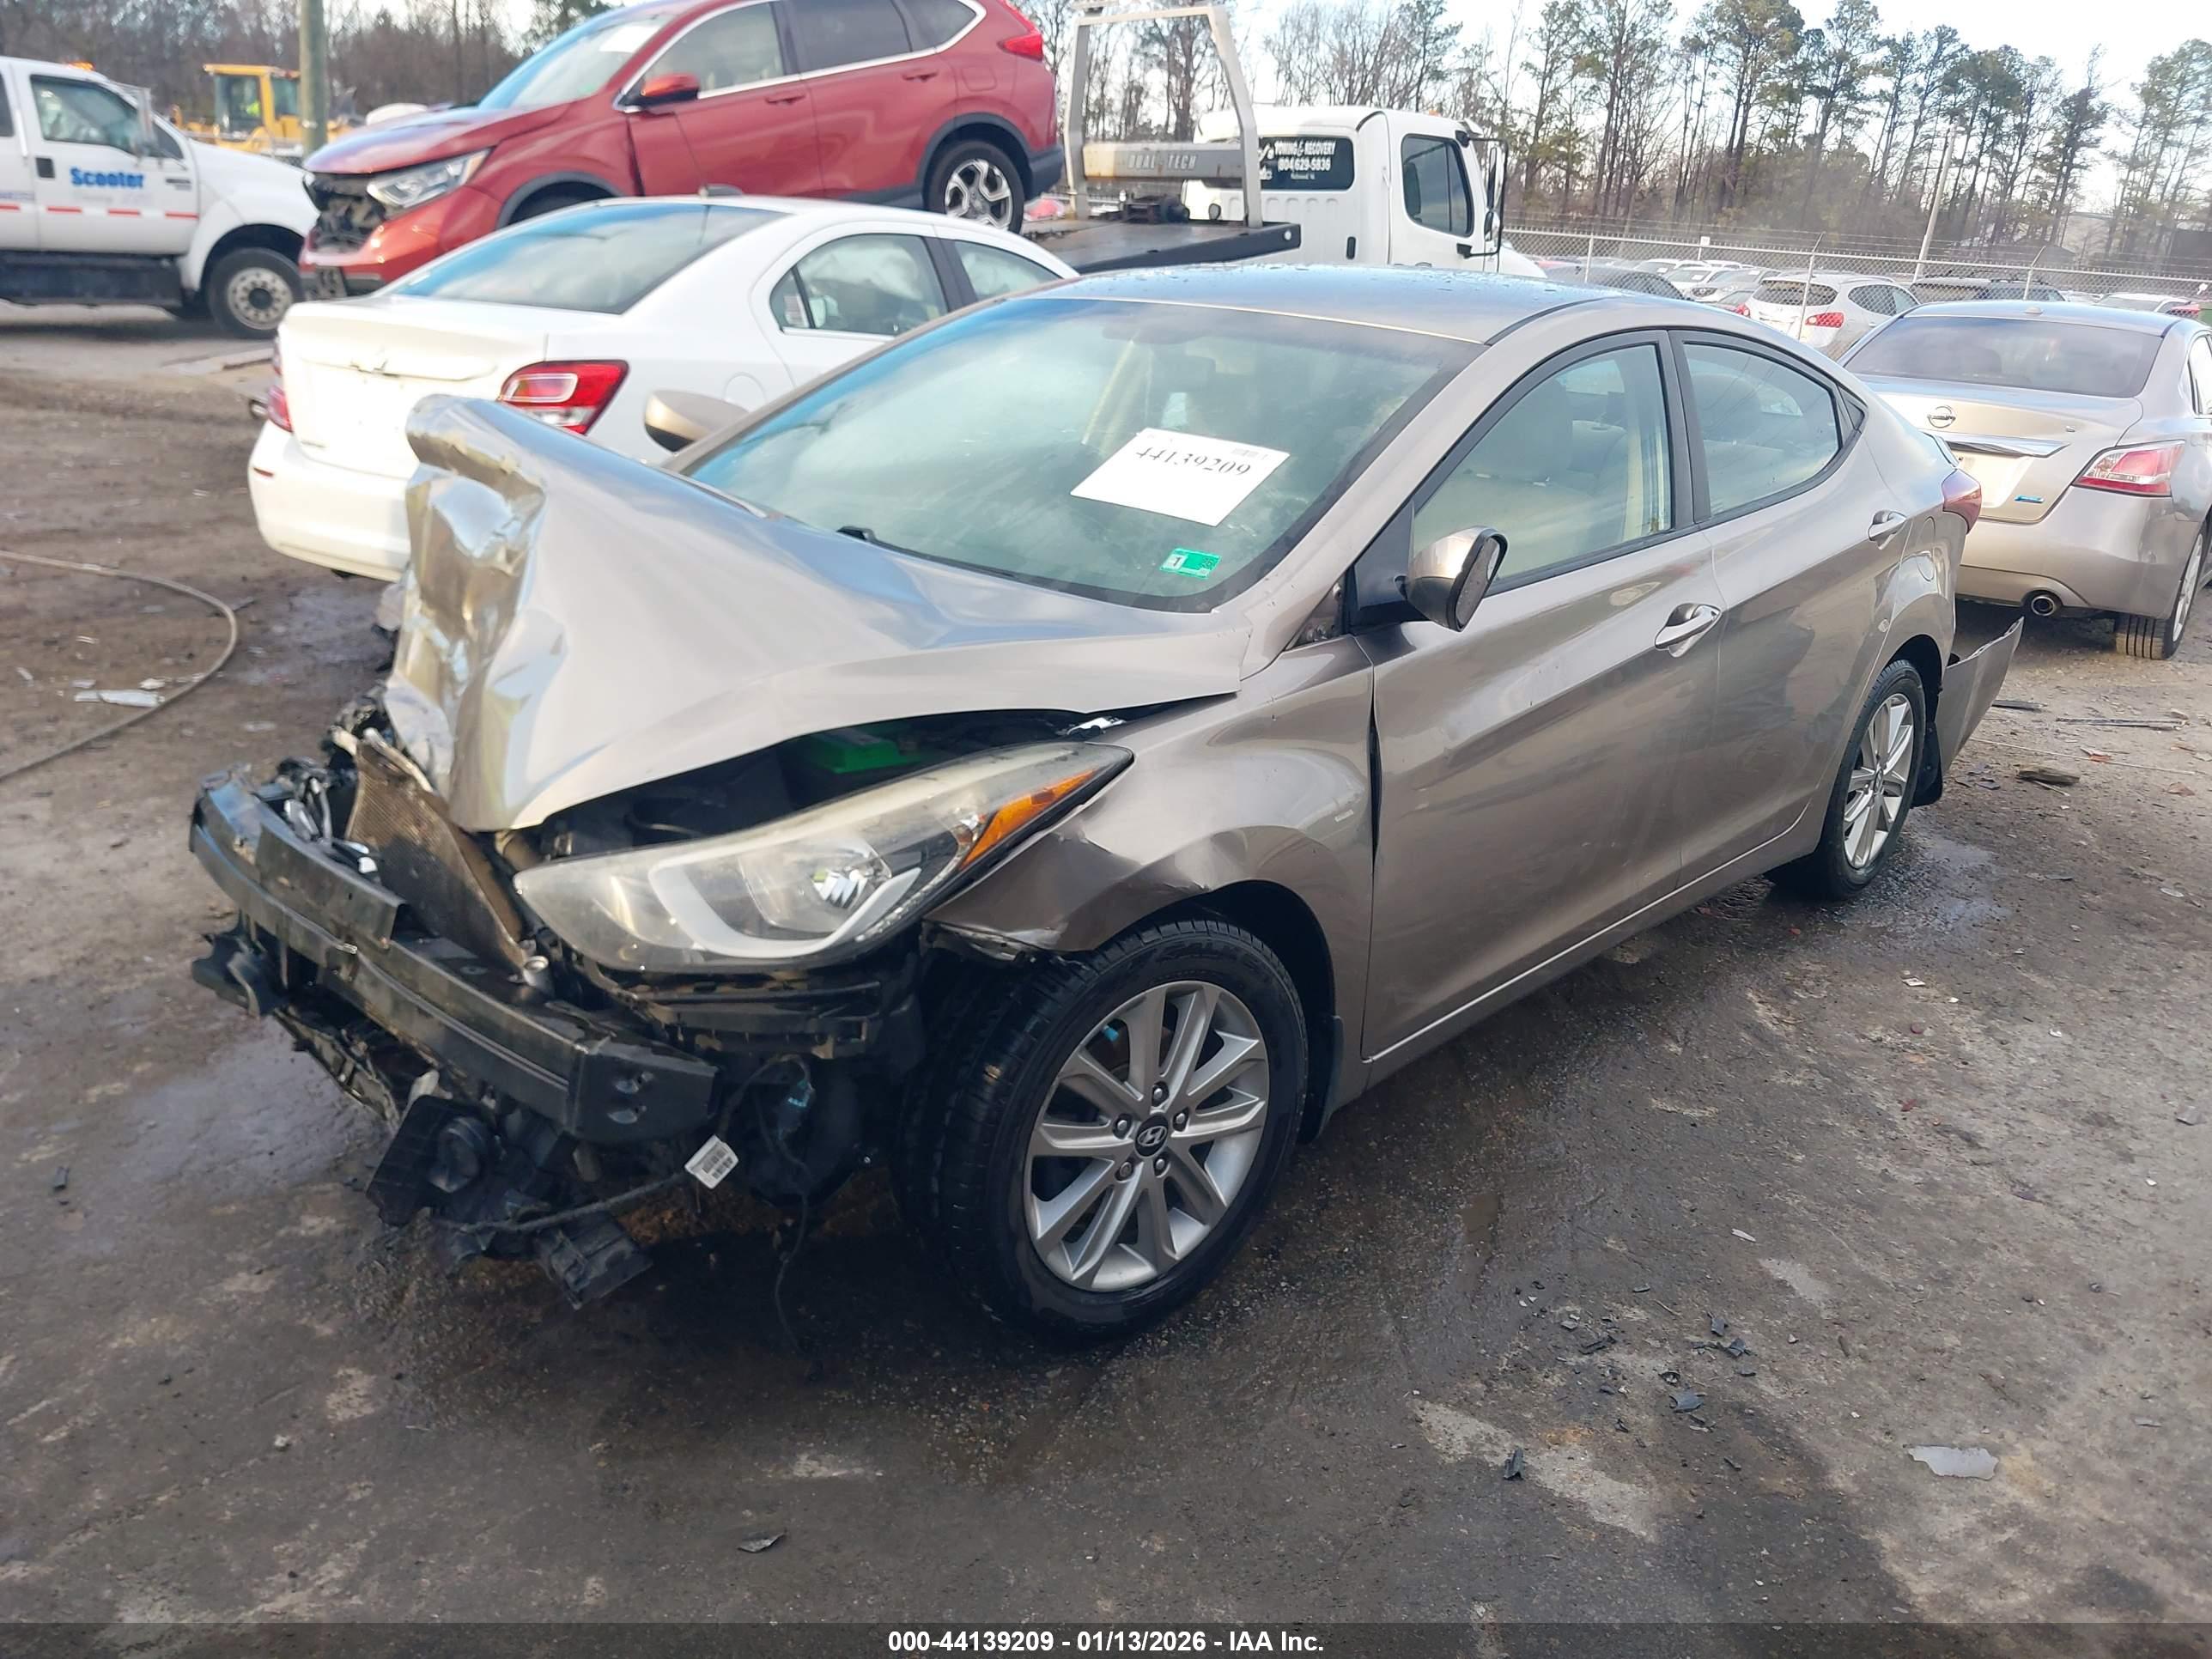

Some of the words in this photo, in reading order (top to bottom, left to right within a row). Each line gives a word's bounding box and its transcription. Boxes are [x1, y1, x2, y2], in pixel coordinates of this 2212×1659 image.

[1304, 140, 1336, 155] RECOVERY
[70, 167, 143, 188] Scooter
[1136, 447, 1251, 476] 44139209
